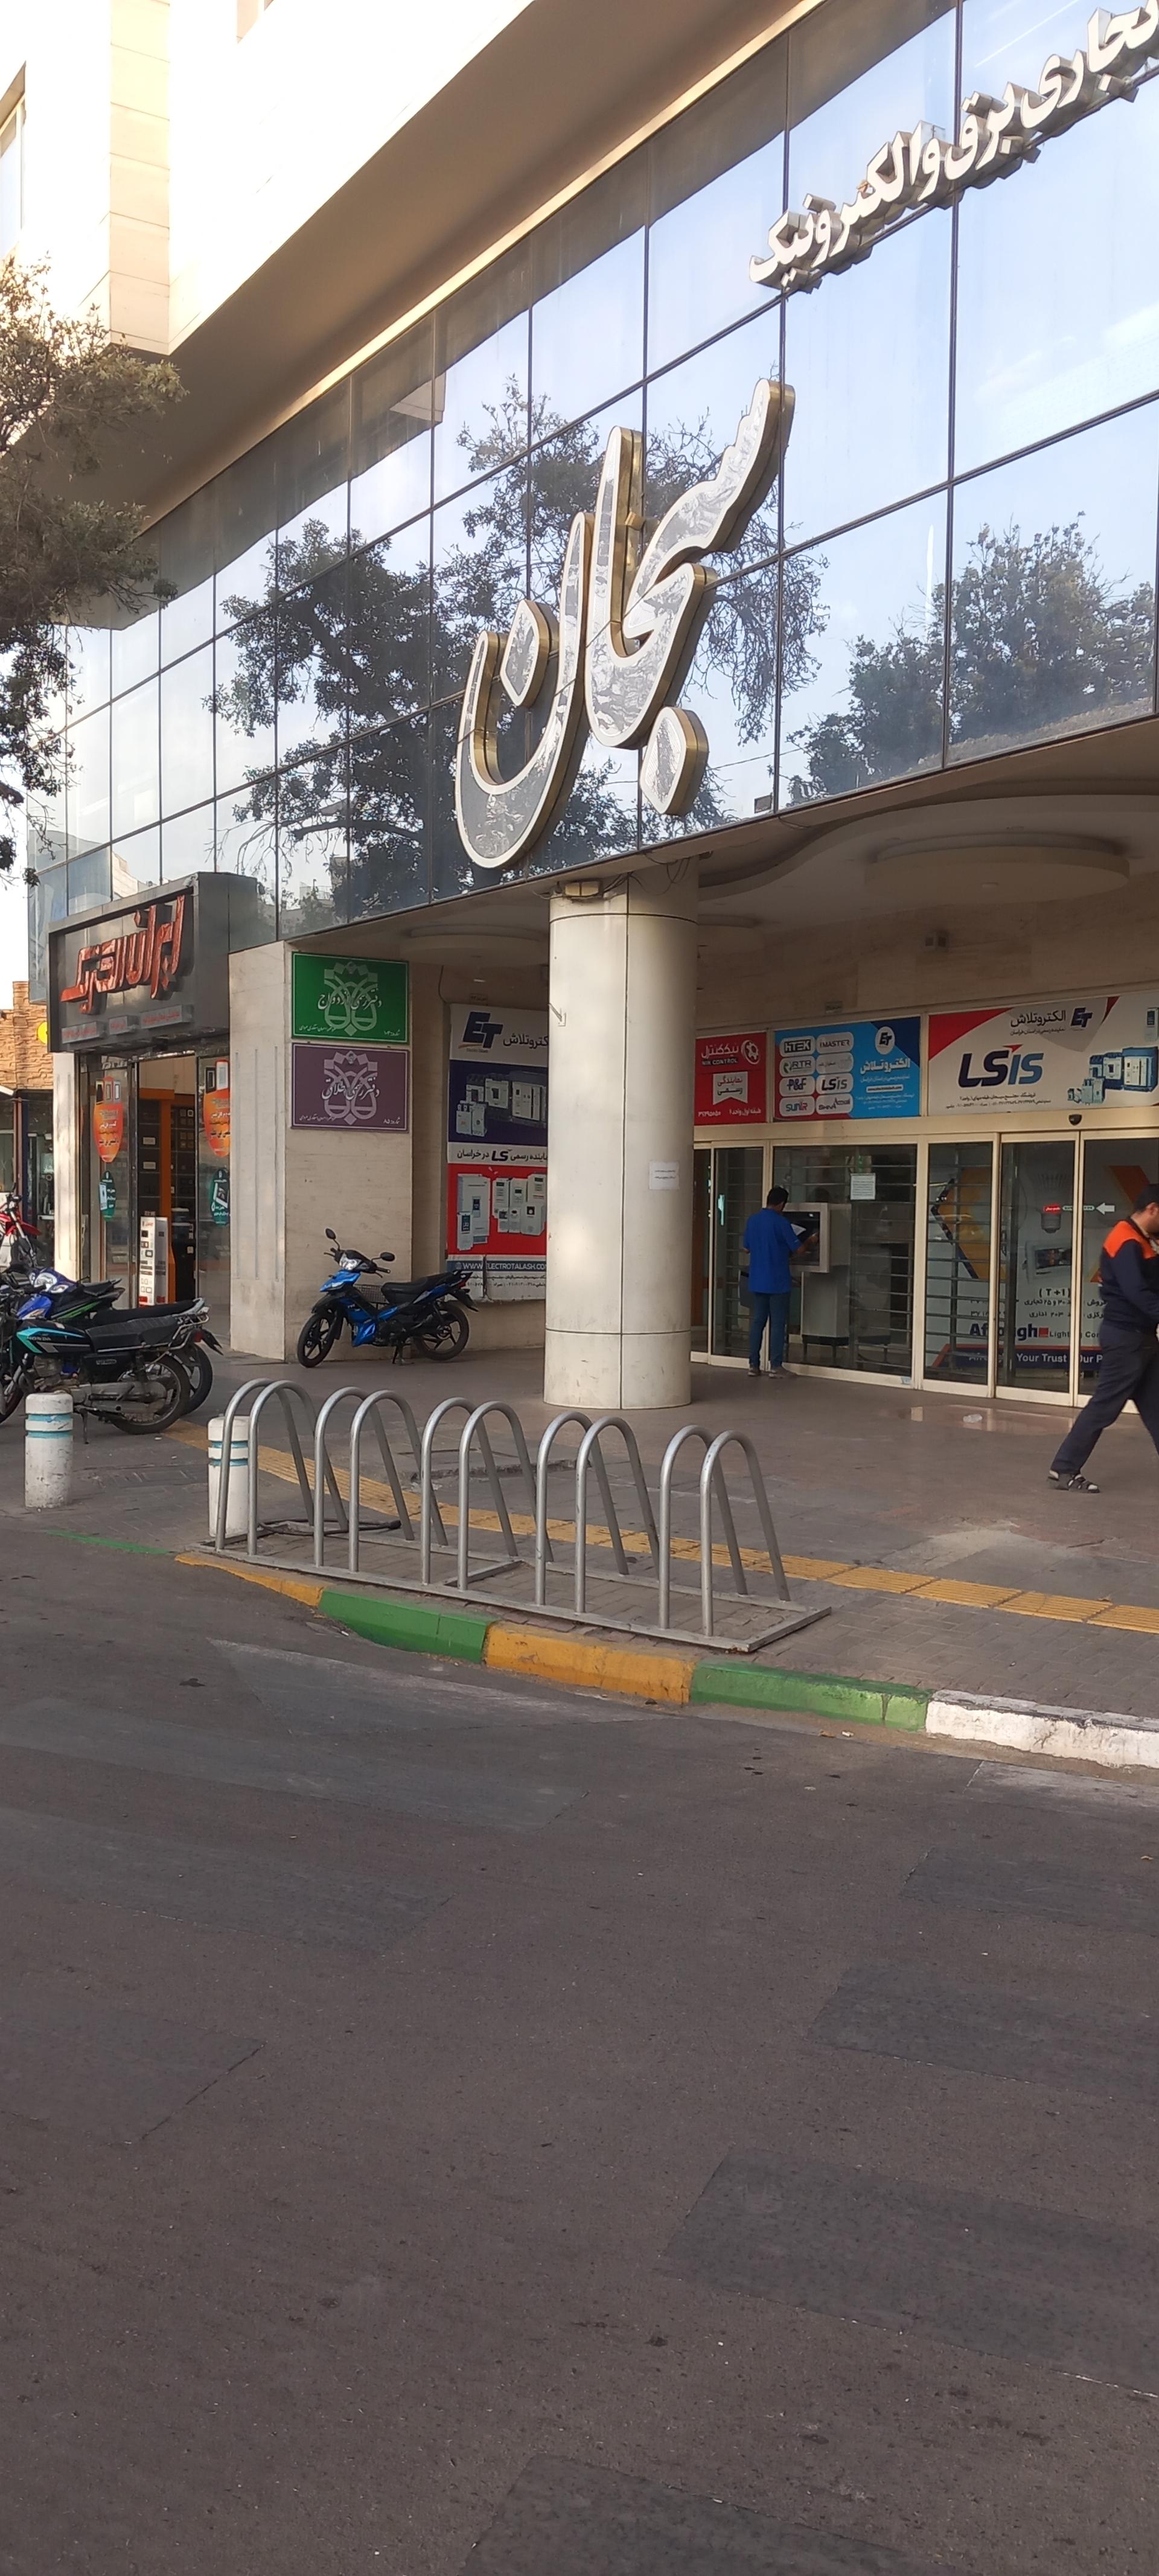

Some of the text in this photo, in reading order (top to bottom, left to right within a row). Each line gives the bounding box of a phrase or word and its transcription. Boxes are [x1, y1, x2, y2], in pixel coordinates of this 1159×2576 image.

[945, 83, 1020, 181] برق
[455, 379, 792, 868] سبحان
[1010, 1009, 1067, 1028] الکتروتلاش
[462, 1011, 549, 1049] ET کتروتلاش
[860, 1058, 911, 1075] الکتروتلاش
[457, 1149, 482, 1159] خراسان
[491, 1151, 509, 1161] LS
[1017, 1354, 1039, 1363] Your
[1041, 1354, 1068, 1363] Trust
